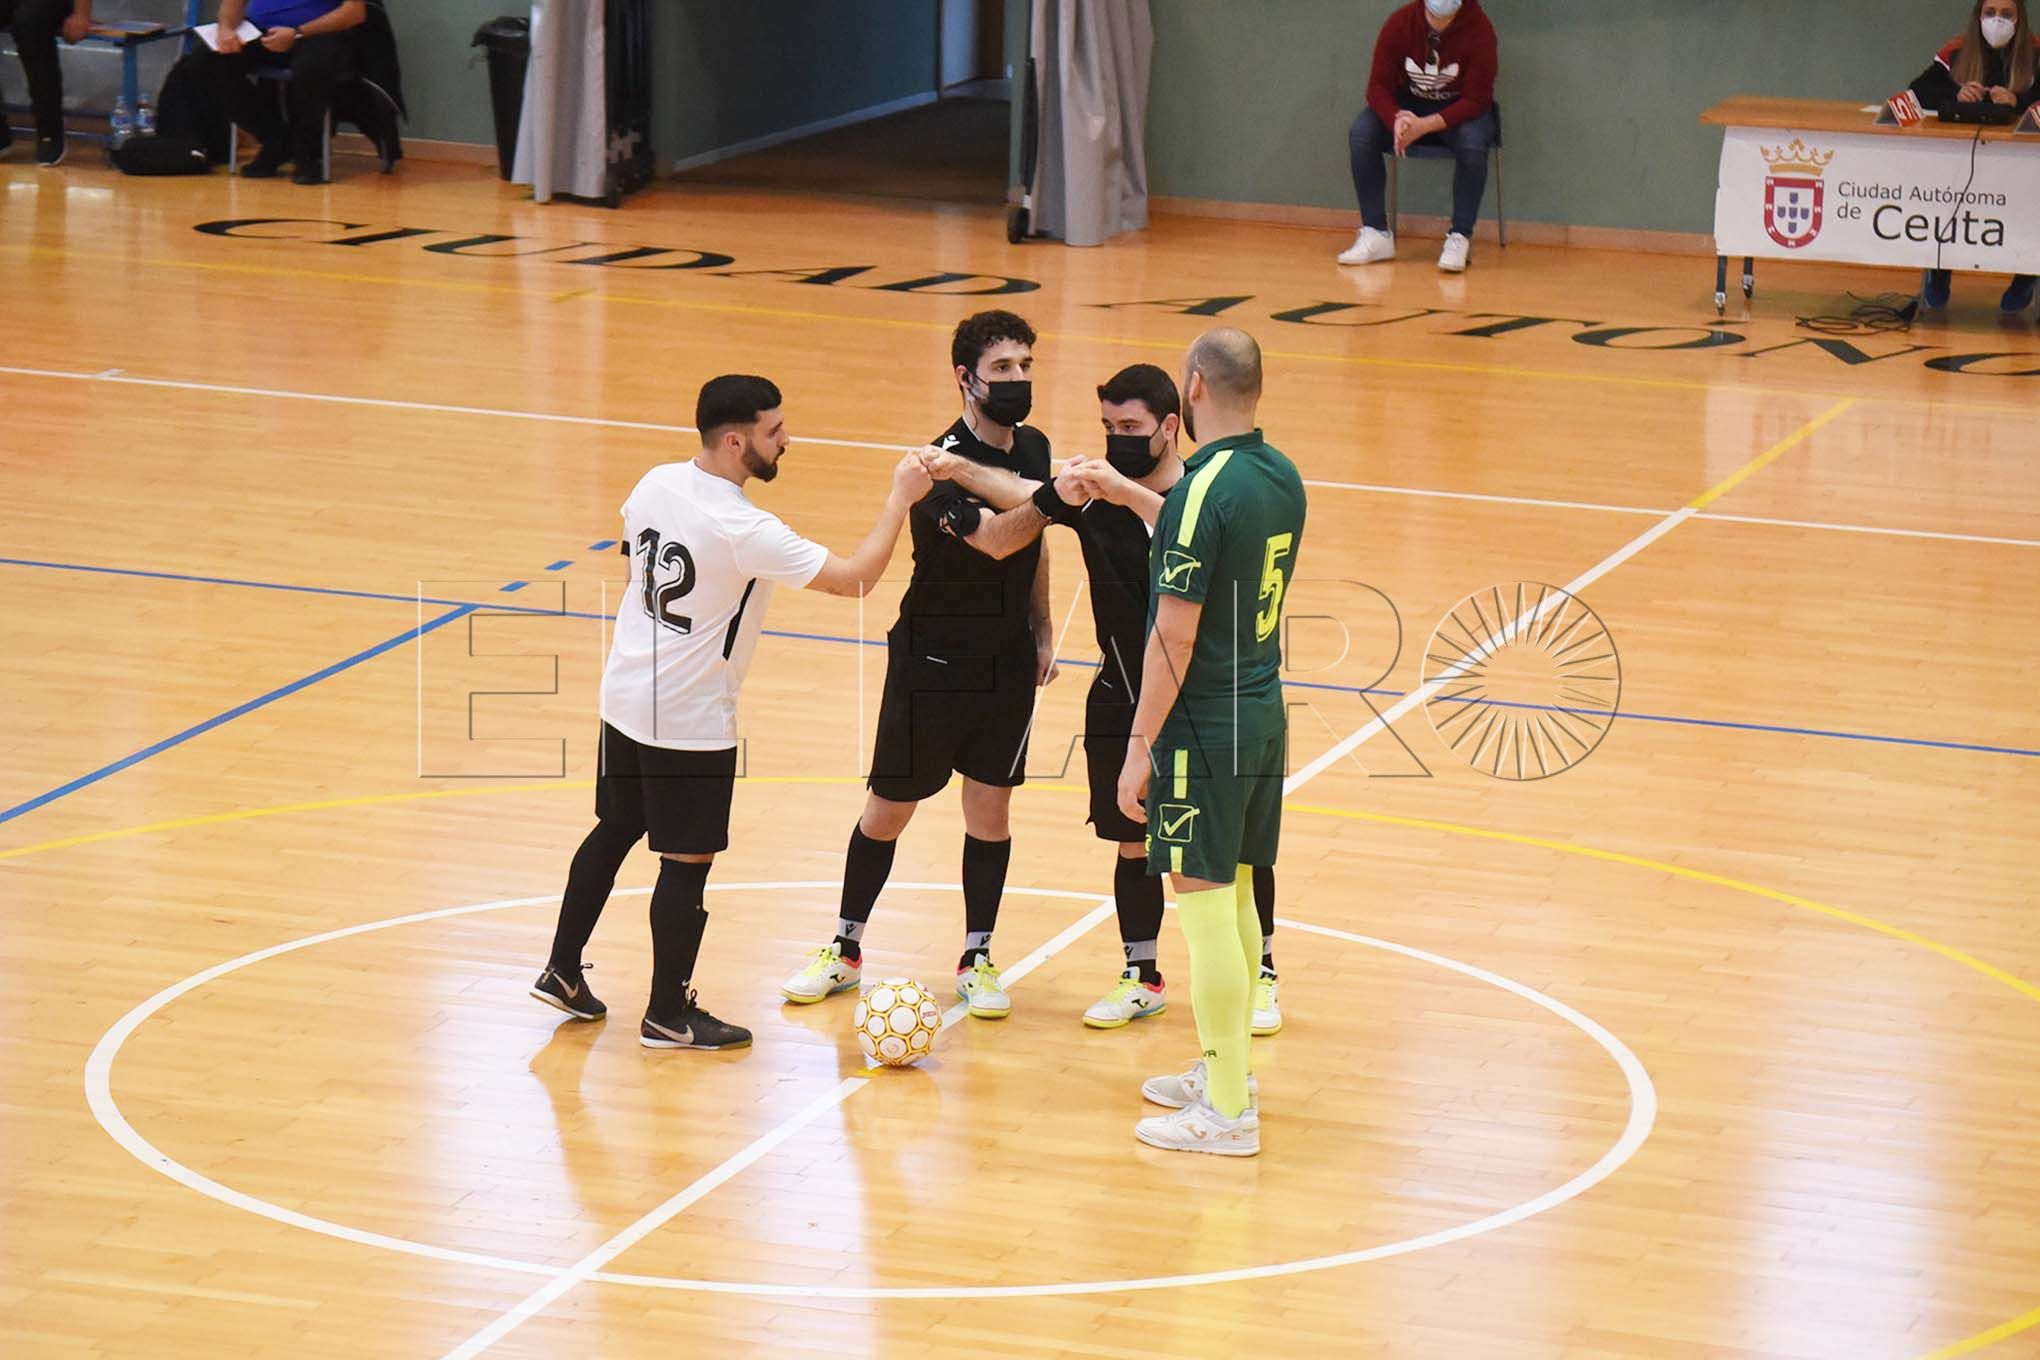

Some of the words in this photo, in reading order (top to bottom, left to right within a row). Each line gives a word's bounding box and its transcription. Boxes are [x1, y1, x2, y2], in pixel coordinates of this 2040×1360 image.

[1836, 202, 1862, 220] de
[1872, 204, 2004, 247] Ceuta
[1838, 181, 1902, 201] Ciudad
[1909, 186, 2007, 206] Autónoma
[190, 217, 1042, 296] CIUDAD
[635, 527, 696, 635] 12
[1255, 532, 1293, 643] 5
